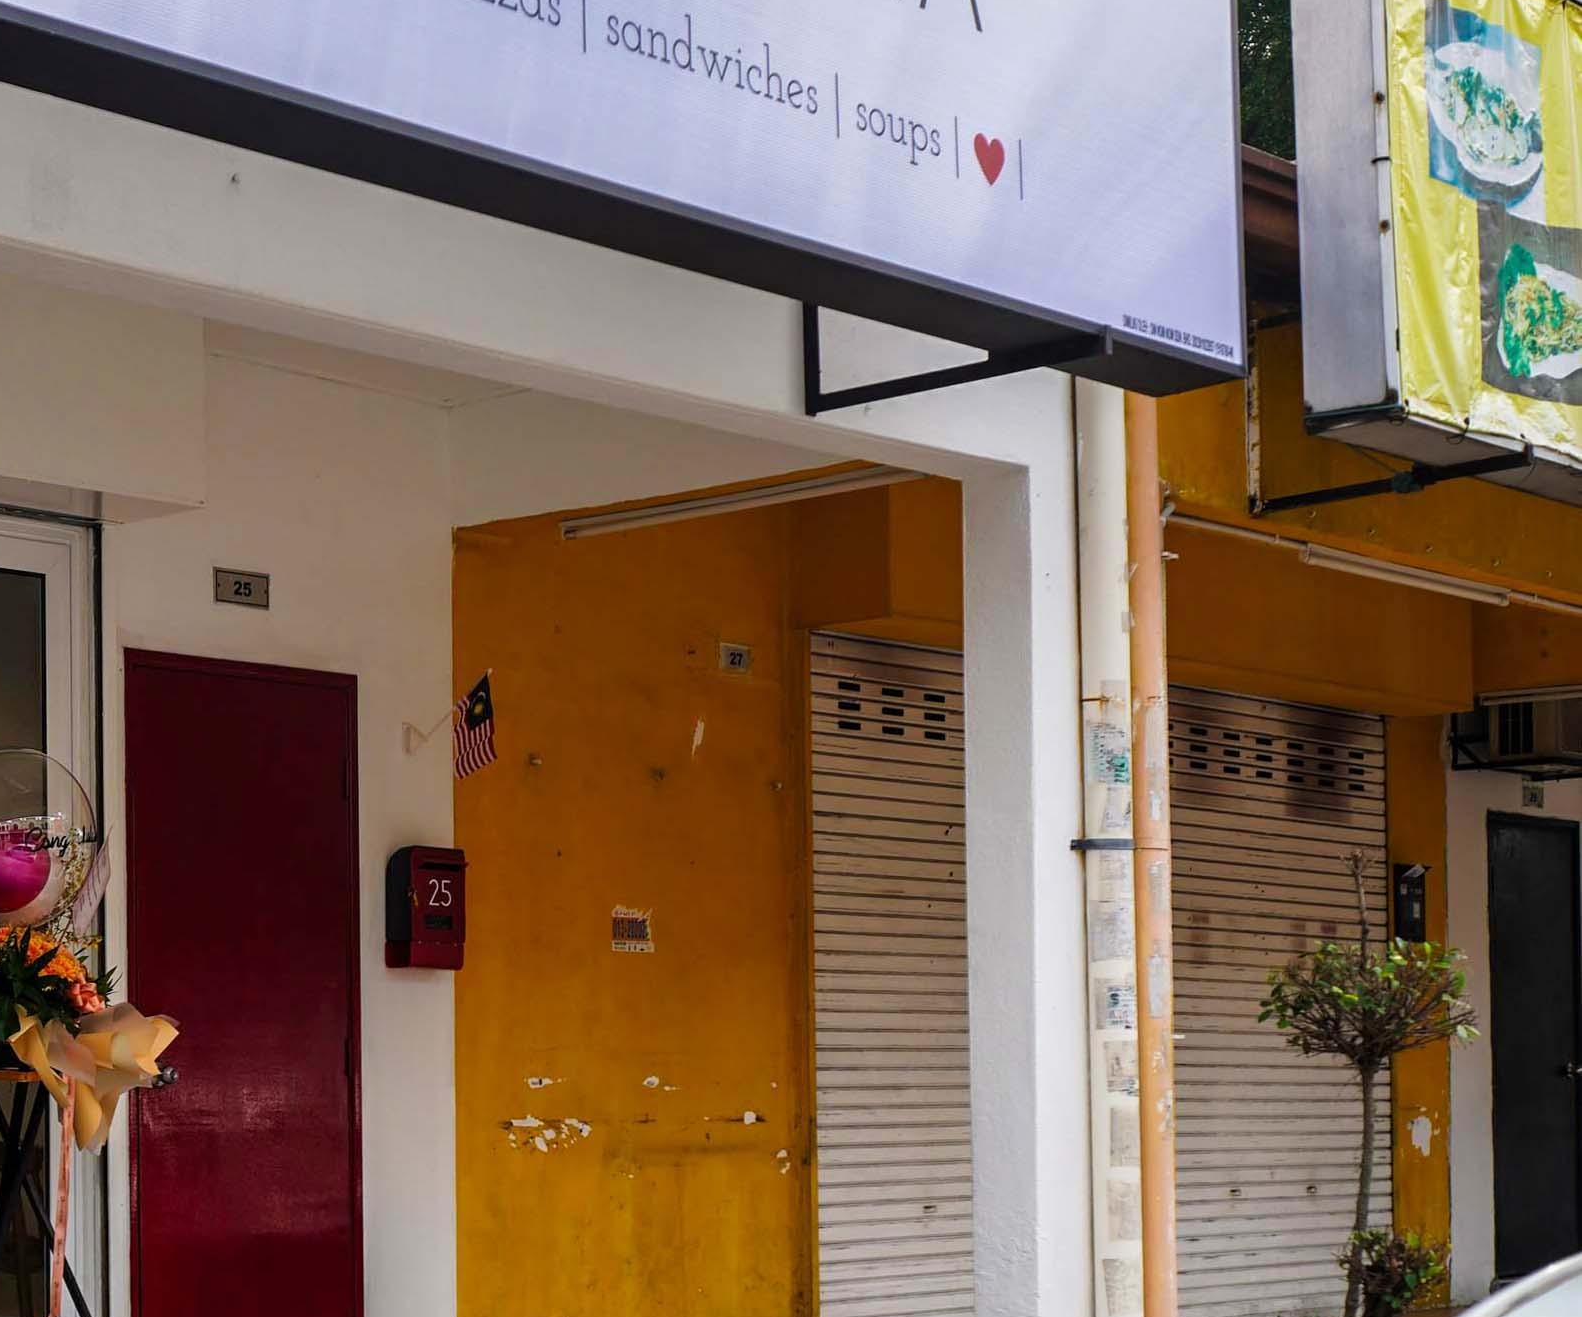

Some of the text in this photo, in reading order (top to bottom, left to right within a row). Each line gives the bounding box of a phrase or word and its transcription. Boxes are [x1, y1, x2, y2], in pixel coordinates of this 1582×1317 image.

[606, 14, 819, 114] sandwiches
[855, 101, 942, 165] soups
[233, 580, 252, 597] 25
[729, 651, 744, 667] 27
[428, 878, 453, 907] 25
